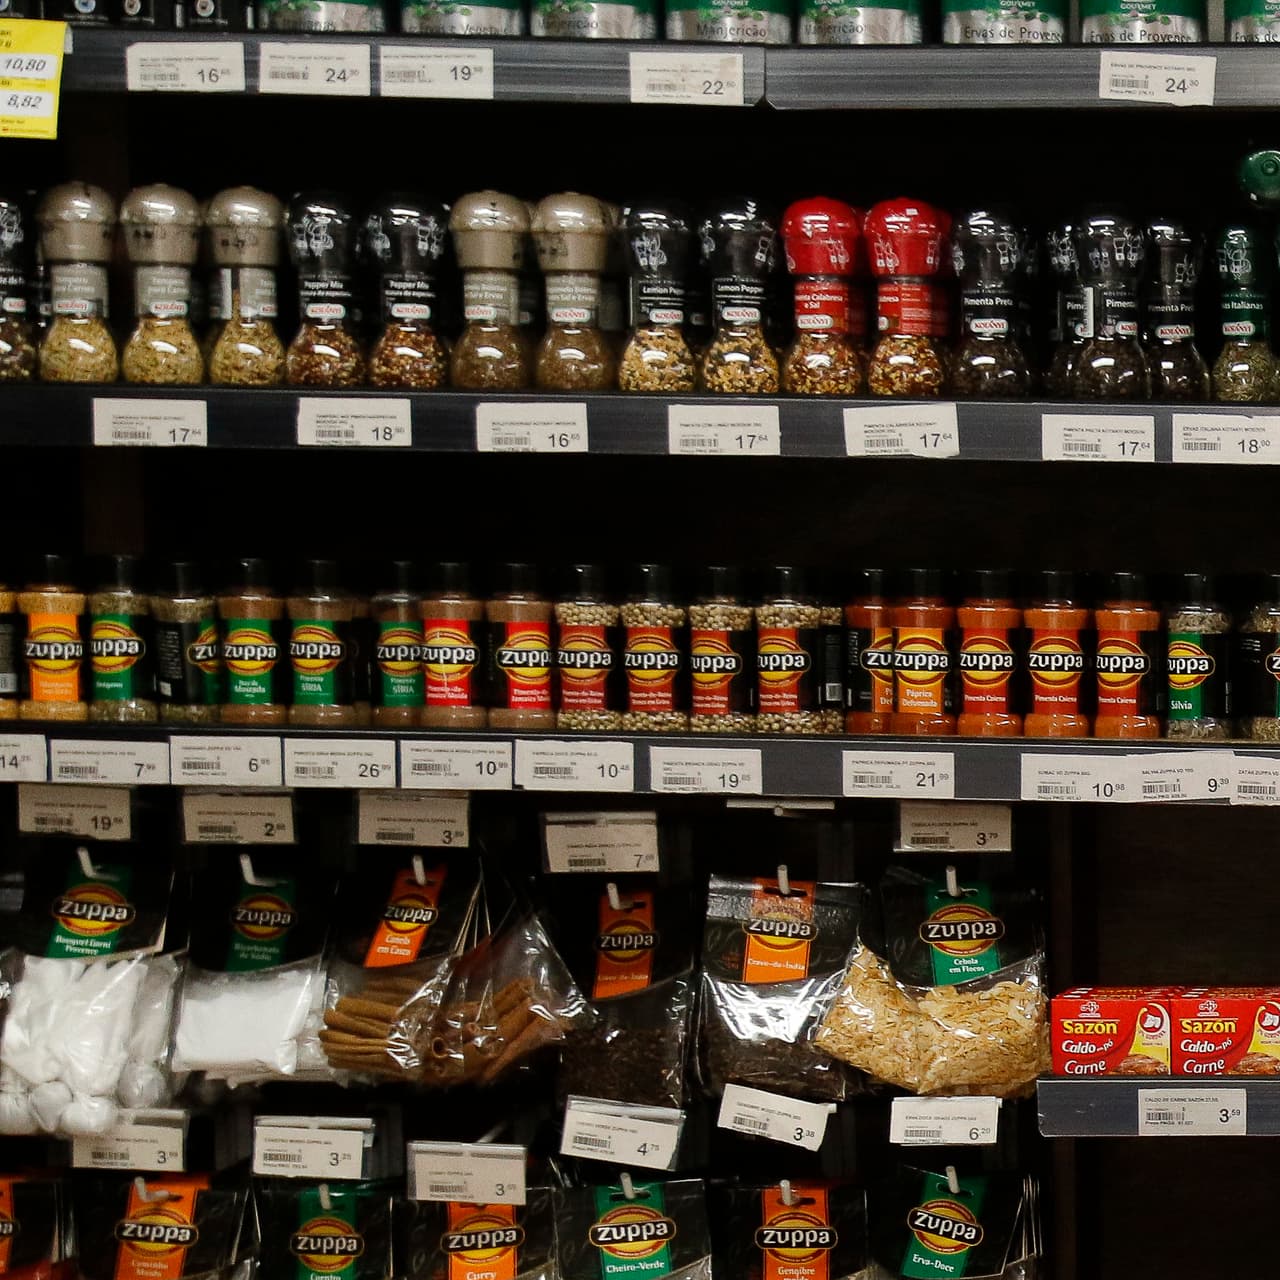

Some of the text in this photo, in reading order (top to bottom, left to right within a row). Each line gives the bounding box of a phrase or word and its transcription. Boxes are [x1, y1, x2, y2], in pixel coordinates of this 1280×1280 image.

[1000, 27, 1015, 39] de
[224, 643, 277, 661] zuppa
[422, 644, 476, 664] zuppa
[893, 652, 949, 672] zuppa
[1029, 652, 1084, 671] zuppa
[905, 689, 933, 699] Páprica
[1171, 700, 1193, 711] Sálvia
[60, 901, 128, 923] zuppa
[926, 921, 998, 941] zuppa
[1062, 1019, 1118, 1035] Sazón
[1061, 1039, 1114, 1053] Caldo pó
[1064, 1058, 1107, 1074] Carne
[605, 1260, 665, 1275] Cheiro-Verde
[912, 1253, 955, 1273] Erva-Doce
